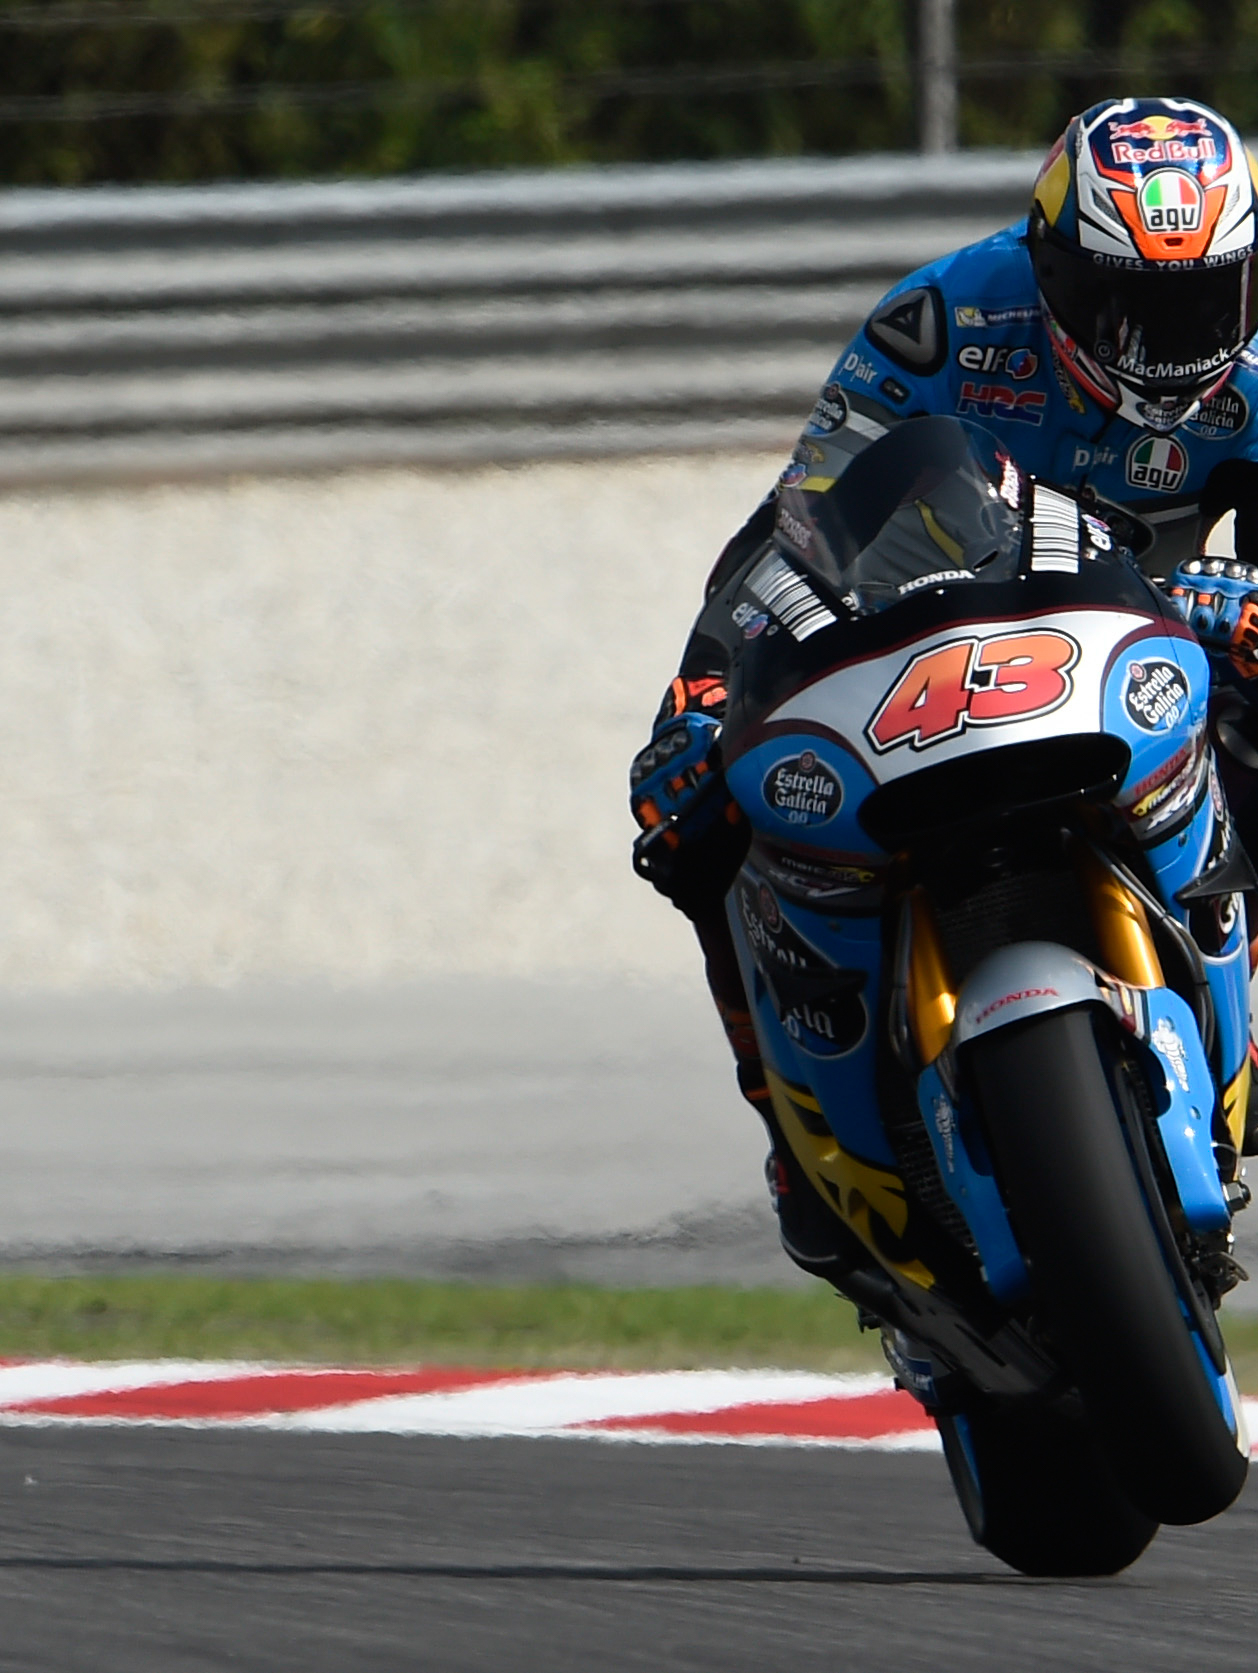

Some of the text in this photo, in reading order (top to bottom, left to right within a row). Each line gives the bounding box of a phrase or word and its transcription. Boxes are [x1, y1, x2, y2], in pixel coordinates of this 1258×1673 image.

[1111, 138, 1216, 164] Red Bull
[1150, 206, 1196, 231] agv
[1093, 246, 1254, 271] GIVES YOU WINGS
[958, 345, 1009, 373] elf
[1117, 348, 1231, 379] MacManiack
[956, 381, 1048, 427] HRC
[1133, 463, 1178, 491] agv
[899, 568, 976, 595] HONDA
[863, 627, 1082, 754] 43
[1128, 666, 1175, 711] Estrella
[1143, 683, 1184, 724] Galicia
[774, 767, 834, 796] Estrella
[775, 787, 827, 814] Galicia
[976, 986, 1060, 1024] HONDA
